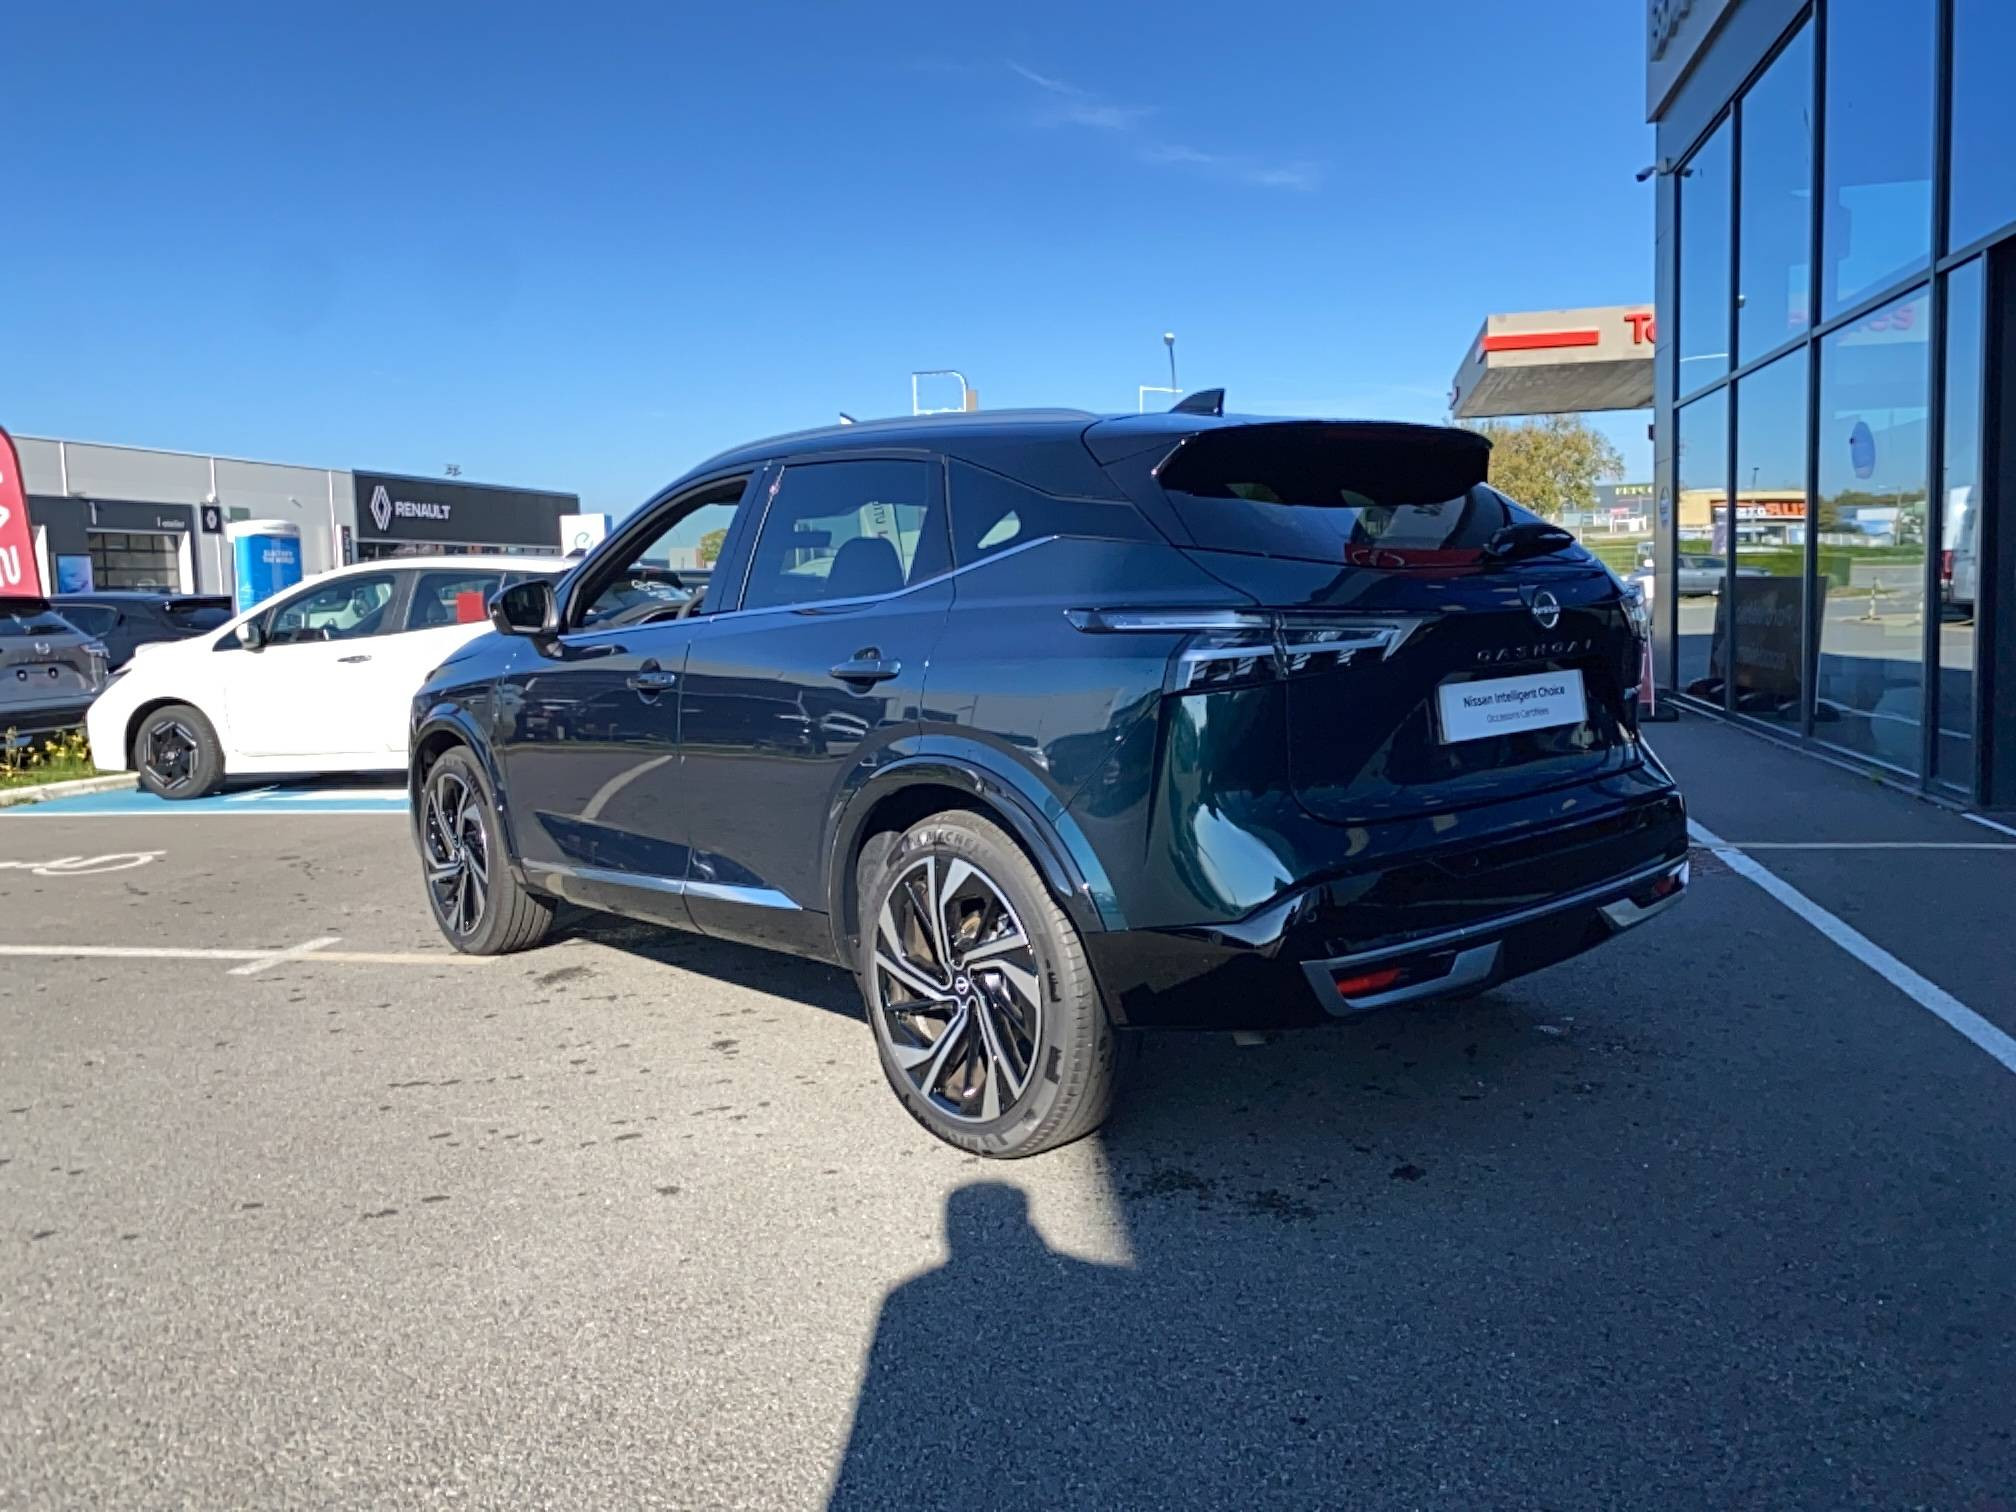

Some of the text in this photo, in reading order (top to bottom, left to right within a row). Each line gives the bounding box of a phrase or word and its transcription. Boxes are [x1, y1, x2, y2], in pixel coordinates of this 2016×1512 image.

[394, 501, 451, 519] RENAULT
[1463, 685, 1565, 708] Nissan Intelligent Choice
